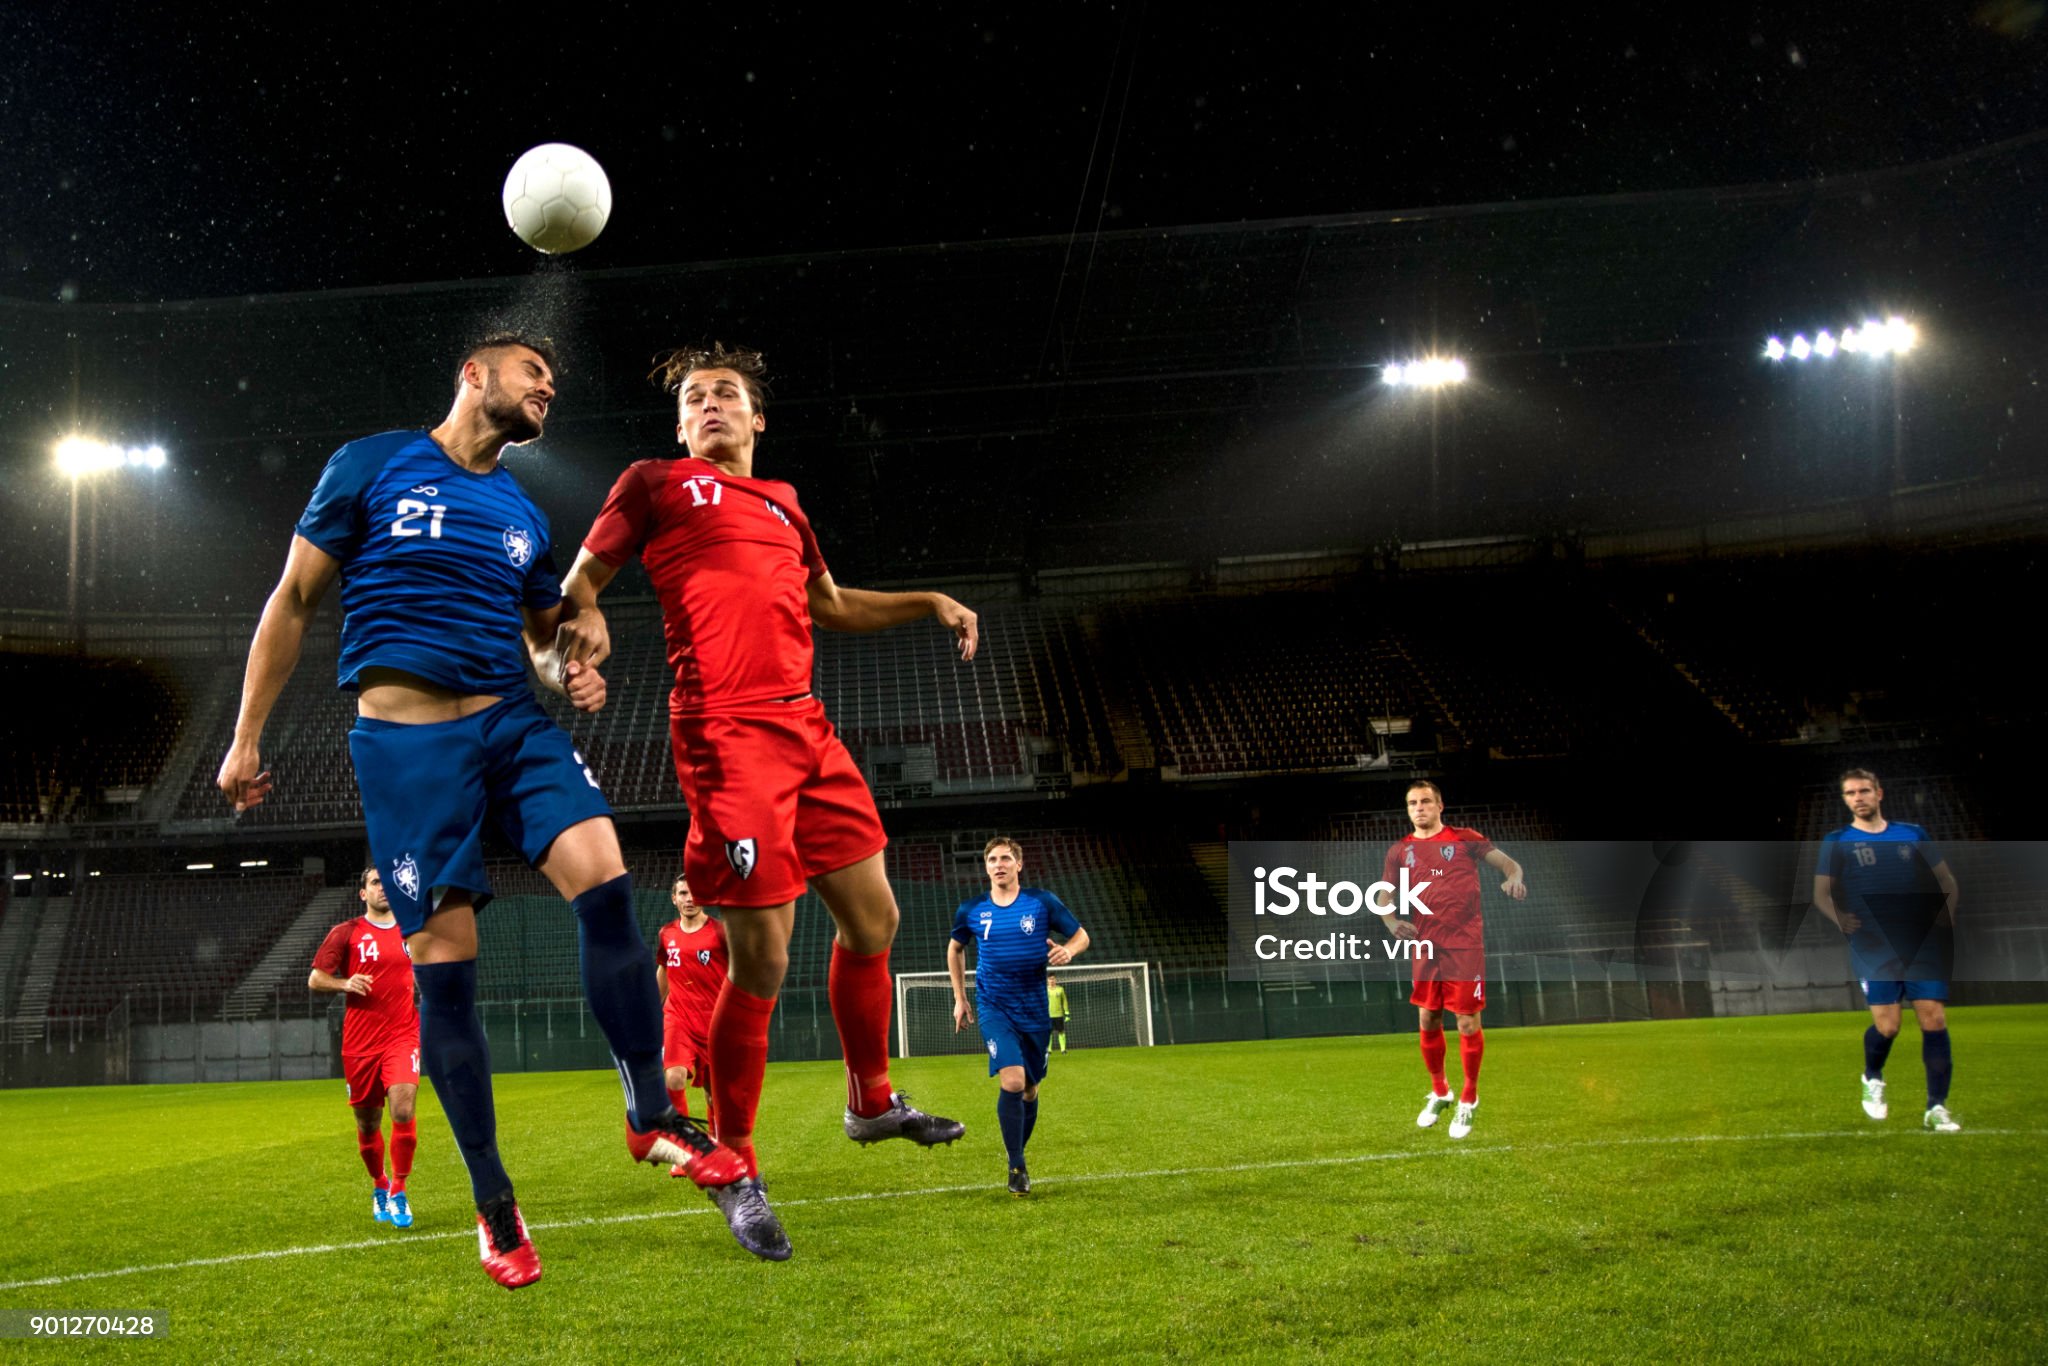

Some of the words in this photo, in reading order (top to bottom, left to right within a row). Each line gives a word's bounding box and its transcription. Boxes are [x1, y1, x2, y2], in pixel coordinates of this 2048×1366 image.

[682, 478, 722, 507] 17
[391, 498, 446, 539] 21
[1405, 851, 1415, 868] 4
[1853, 847, 1877, 867] 18
[980, 919, 993, 940] 7
[357, 941, 380, 963] 14
[1473, 982, 1482, 1001] 4
